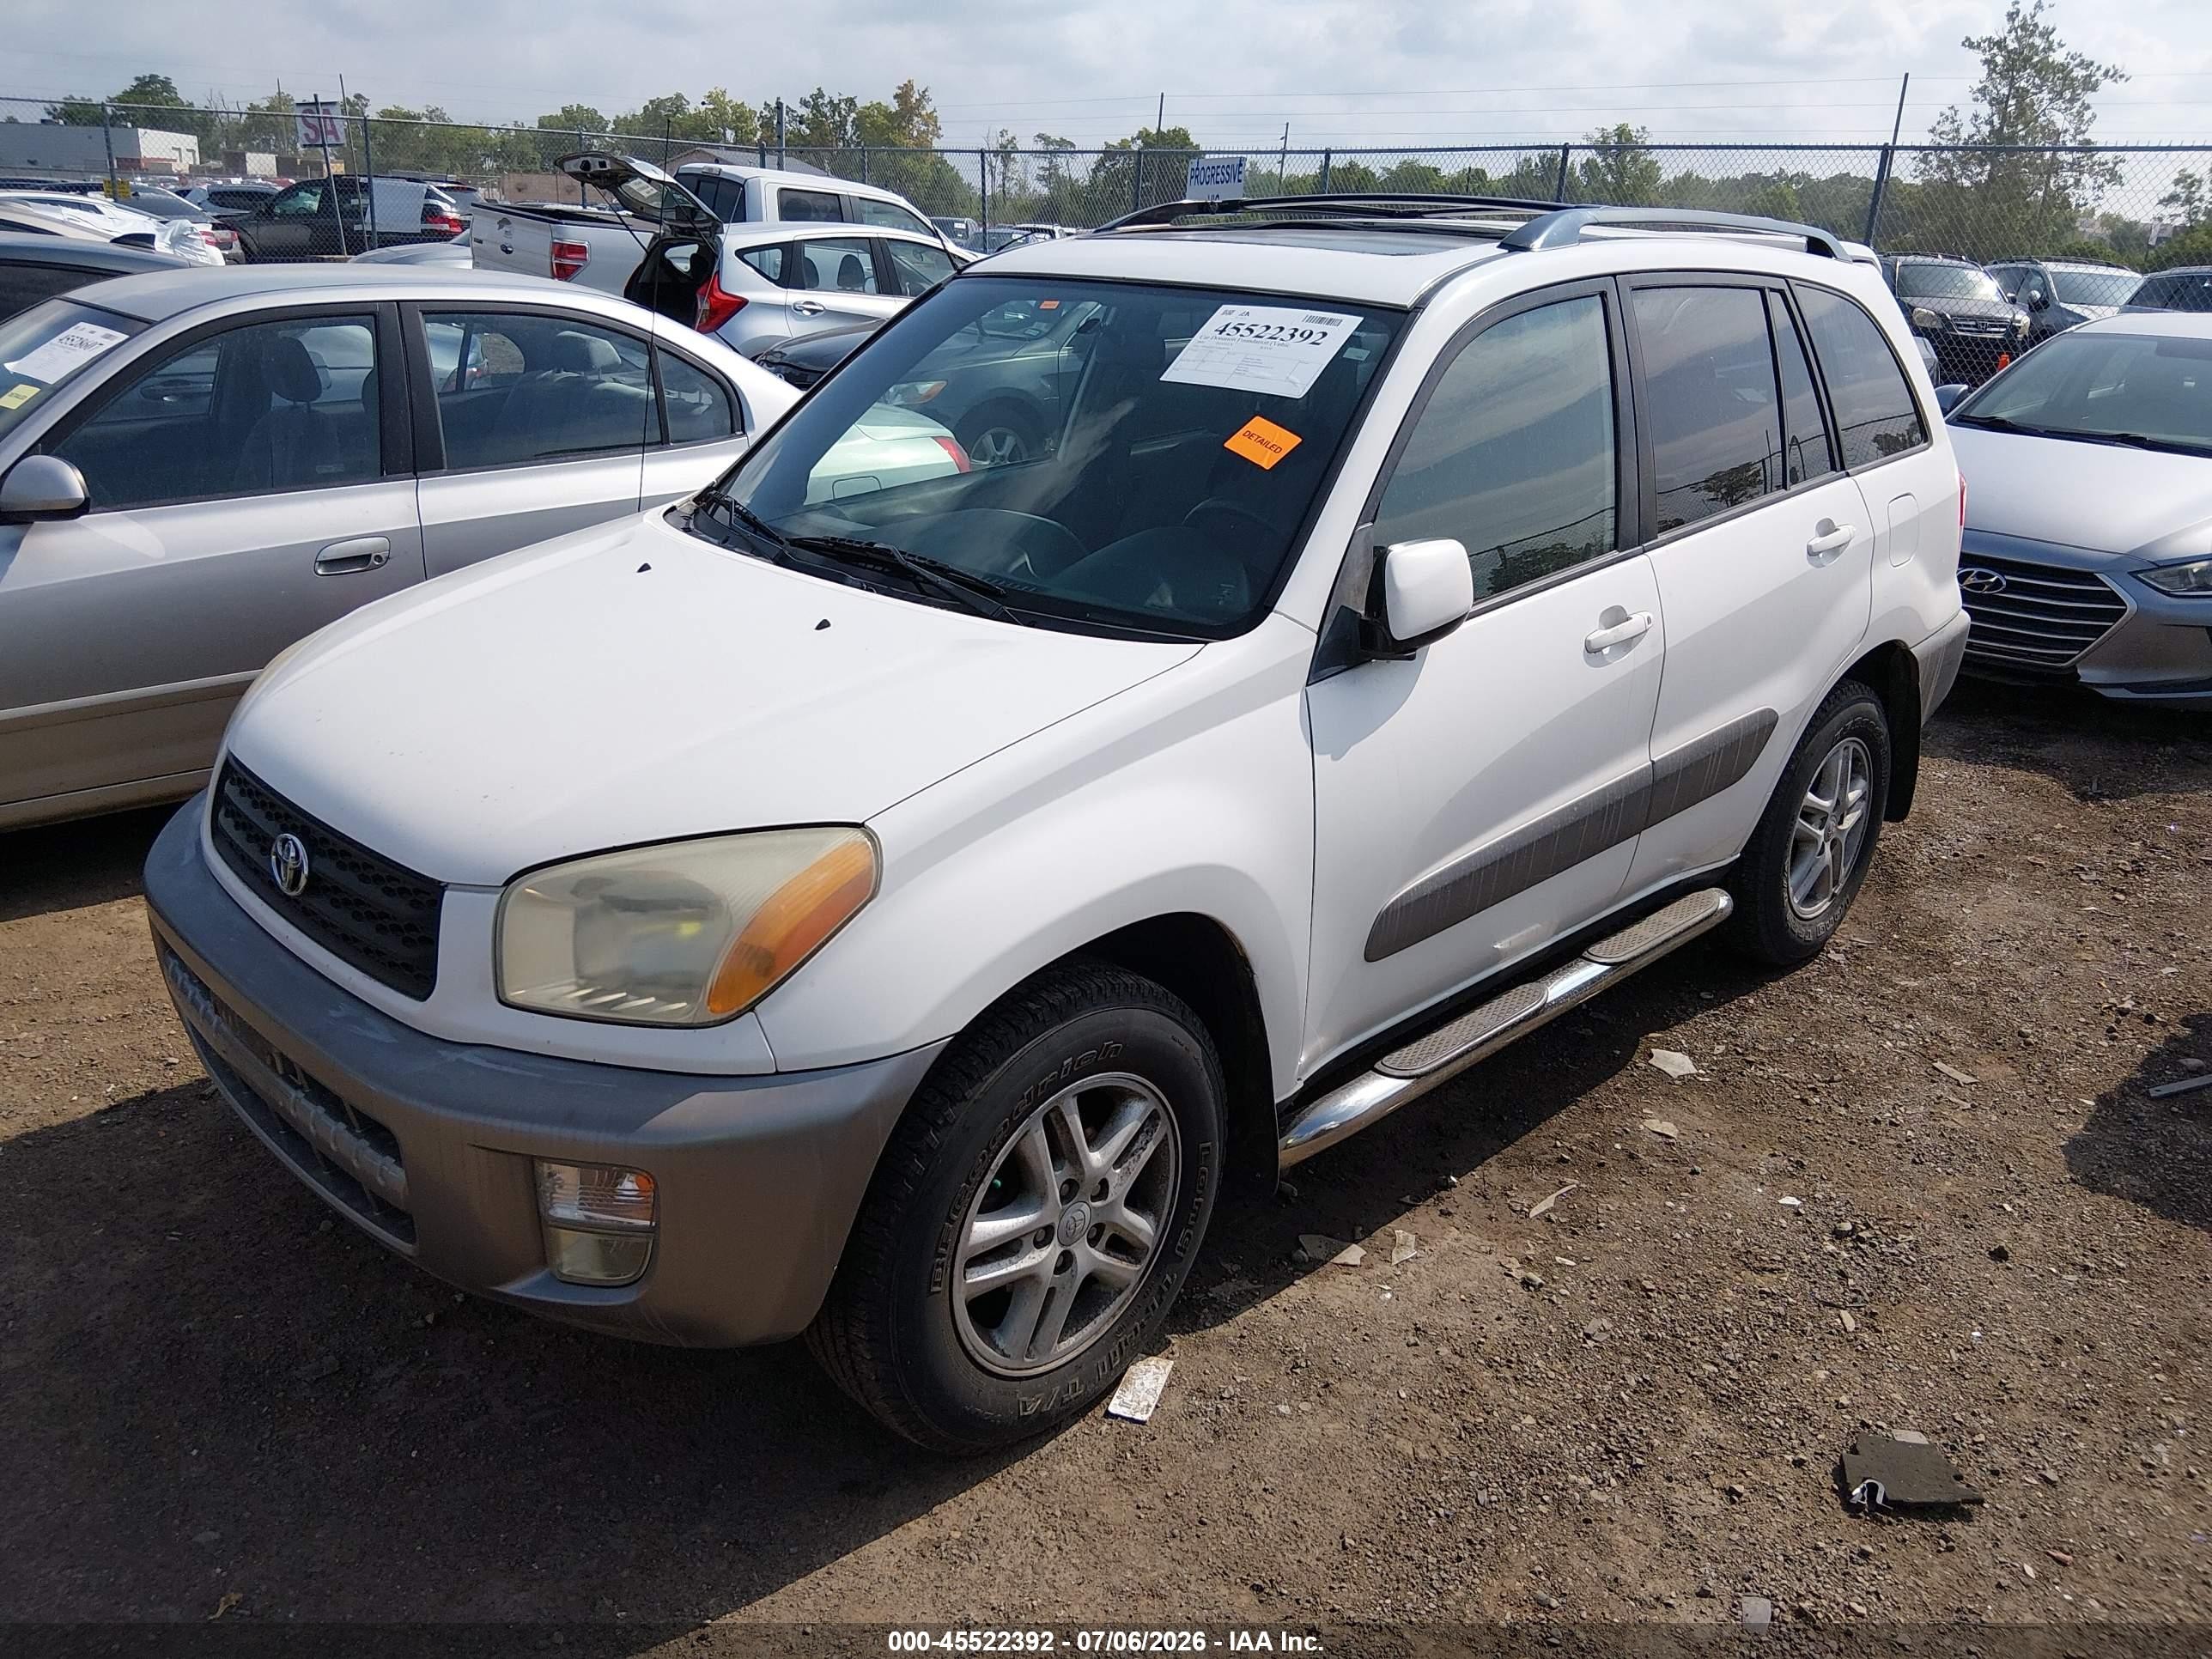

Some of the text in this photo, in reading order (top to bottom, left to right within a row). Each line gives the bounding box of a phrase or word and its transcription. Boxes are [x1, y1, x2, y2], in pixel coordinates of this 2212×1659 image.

[1189, 163, 1243, 186] PROGRESSIVE
[1214, 321, 1328, 346] 45522392
[1242, 429, 1283, 455] DETAILED
